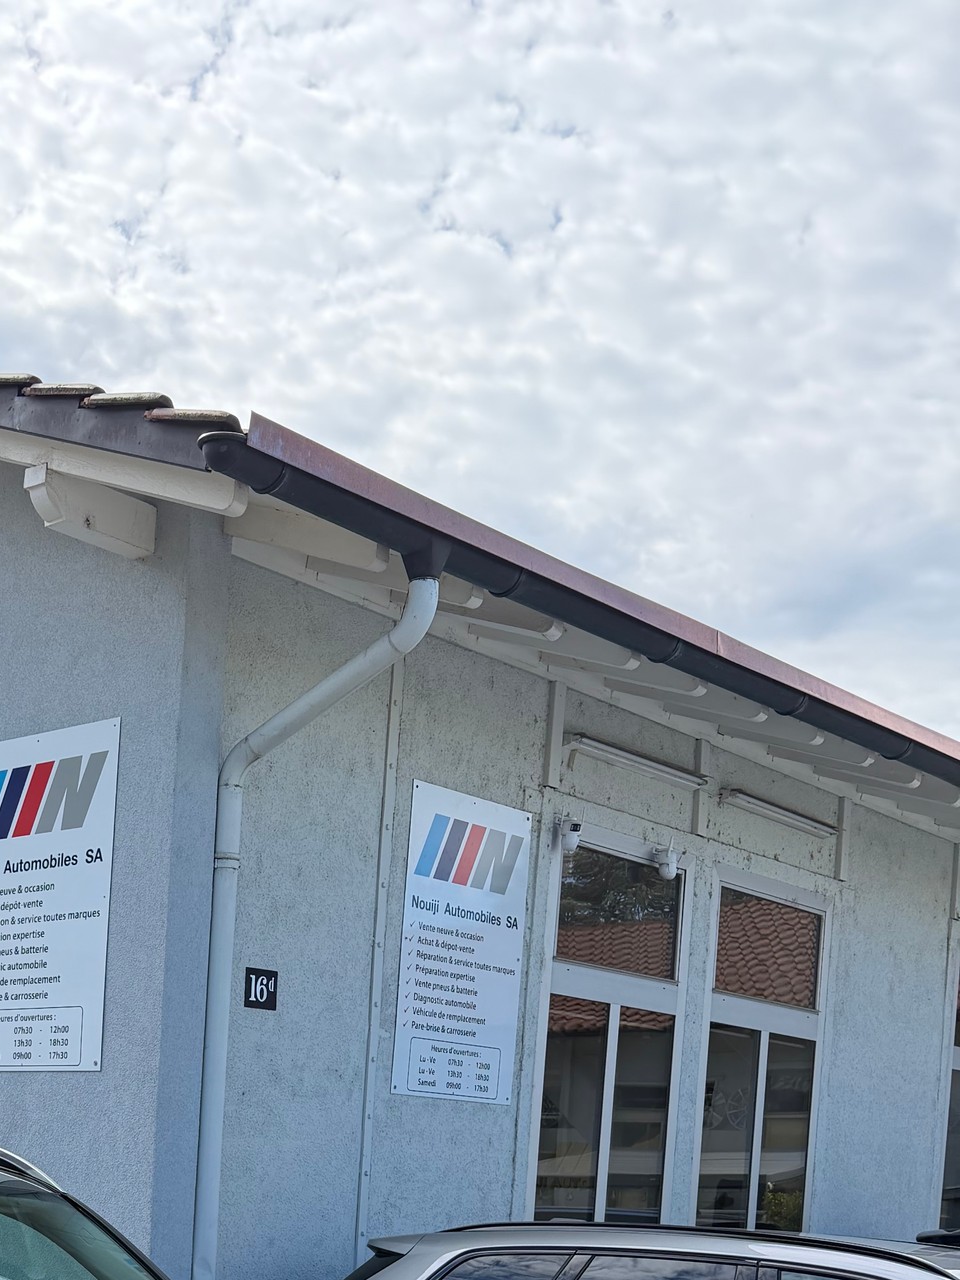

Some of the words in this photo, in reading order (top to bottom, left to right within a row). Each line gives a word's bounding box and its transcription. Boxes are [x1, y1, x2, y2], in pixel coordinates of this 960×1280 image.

[4, 853, 78, 874] Automobiles
[86, 848, 103, 864] SA
[18, 885, 23, 894] &
[25, 883, 55, 893] occasion
[11, 916, 16, 925] &
[18, 913, 42, 924] service
[43, 912, 66, 922] toutes
[68, 909, 101, 920] marques
[412, 895, 439, 915] Nouiji
[444, 903, 501, 926] Automobiles
[506, 916, 518, 930] SA
[13, 930, 45, 941] expertise
[419, 922, 436, 933] Vente
[437, 927, 454, 937] neuve
[455, 929, 460, 937] &
[460, 930, 484, 942] occasion
[417, 936, 434, 947] Achat
[435, 939, 440, 947] &
[14, 946, 20, 955] &
[21, 944, 49, 955] batterie
[7, 960, 48, 971] automobile
[448, 956, 453, 964] &
[454, 957, 474, 968] service
[475, 962, 491, 971] toutes
[492, 966, 515, 976] marques
[0, 977, 9, 986] de
[10, 975, 61, 987] remplacement
[450, 972, 475, 983] expertise
[415, 978, 431, 989] Vente
[432, 982, 450, 992] pneus
[451, 985, 455, 993] &
[456, 986, 478, 997] batterie
[4, 992, 9, 1001] &
[10, 991, 49, 1001] carrosserie
[413, 993, 444, 1006] Diagnostic
[445, 996, 477, 1011] automobile
[413, 1007, 437, 1018] Véhicule
[438, 1011, 446, 1019] de
[446, 1012, 486, 1025] remplacement
[50, 1026, 69, 1034] 12h00
[412, 1021, 440, 1033] Pare-brise
[441, 1025, 446, 1033] &
[446, 1027, 477, 1038] carrosserie
[49, 1038, 69, 1047] 18h30
[431, 1045, 448, 1054] Heures
[13, 1052, 32, 1060] 09h00
[448, 1059, 463, 1067] 07h30
[476, 1062, 490, 1070] 12h00
[418, 1079, 436, 1087] Samedi
